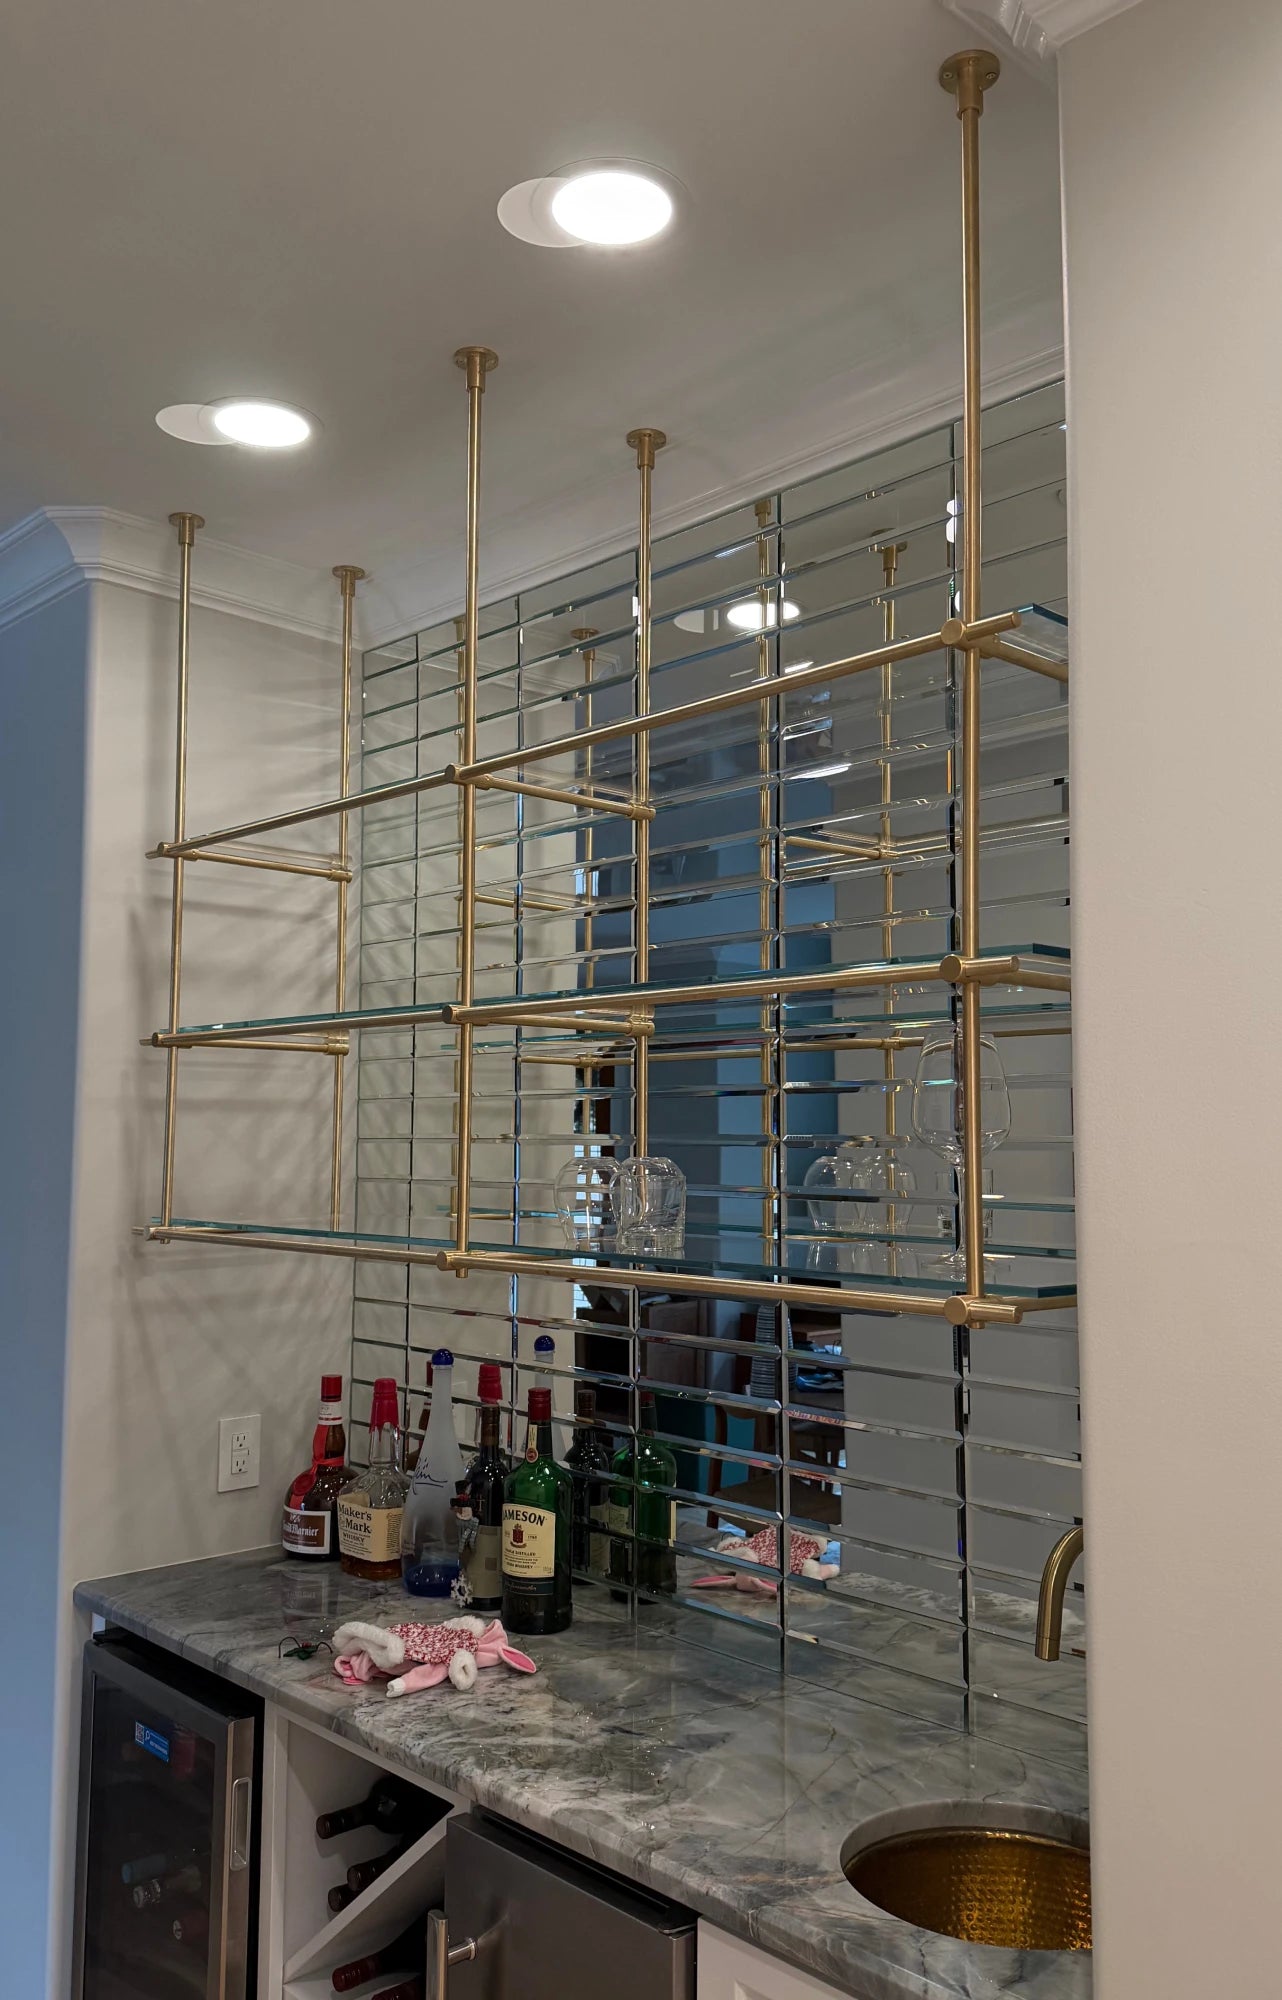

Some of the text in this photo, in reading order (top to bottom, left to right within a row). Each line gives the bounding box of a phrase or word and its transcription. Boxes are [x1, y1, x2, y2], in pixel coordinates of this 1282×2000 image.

[338, 1503, 372, 1521] Maker's
[503, 1509, 546, 1526] AMESON
[292, 1523, 319, 1537] Marnier
[345, 1518, 371, 1534] Mark
